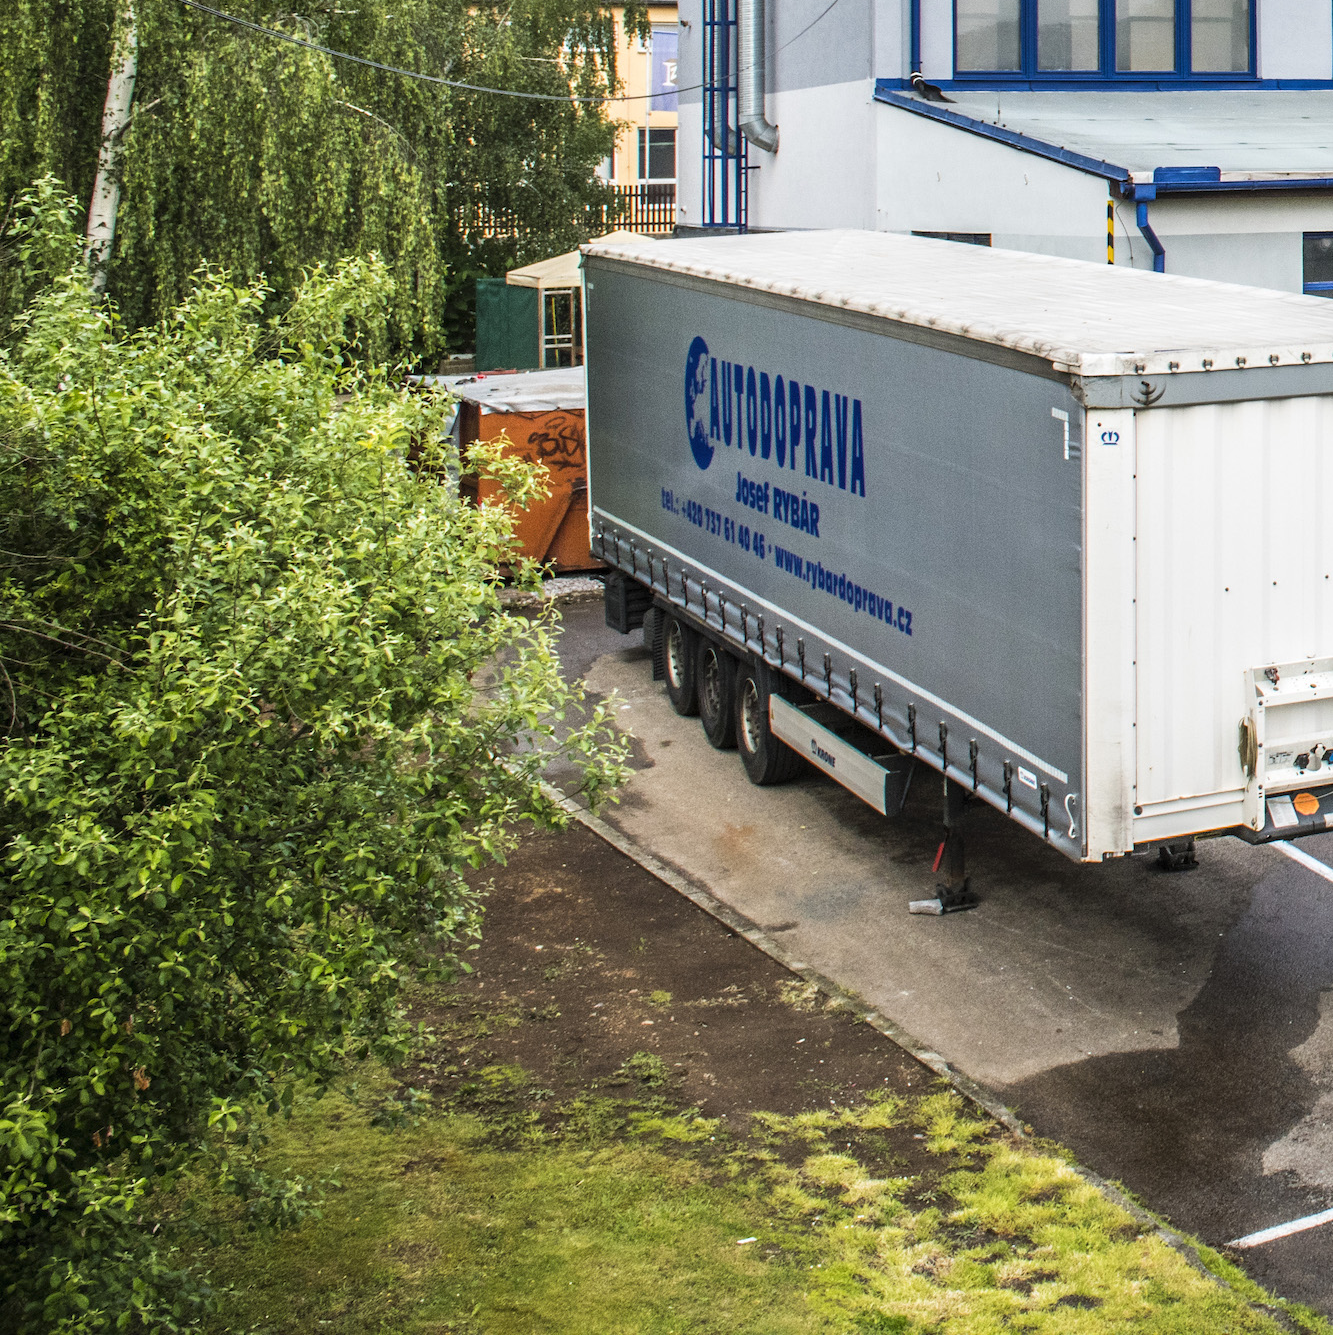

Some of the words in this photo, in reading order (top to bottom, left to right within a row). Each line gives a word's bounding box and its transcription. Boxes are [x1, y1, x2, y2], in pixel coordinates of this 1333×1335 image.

[710, 357, 866, 498] AUTODOPRAVA
[736, 471, 770, 515] Josef
[773, 486, 820, 538] RYBÁR
[661, 486, 680, 516] tel.:
[682, 500, 703, 528] +420
[705, 508, 722, 537] 737
[724, 517, 735, 544] 61
[738, 524, 750, 553] 40
[752, 531, 765, 560] 46
[775, 545, 913, 636] www.rybardoprava.cz
[817, 746, 836, 768] KRONE
